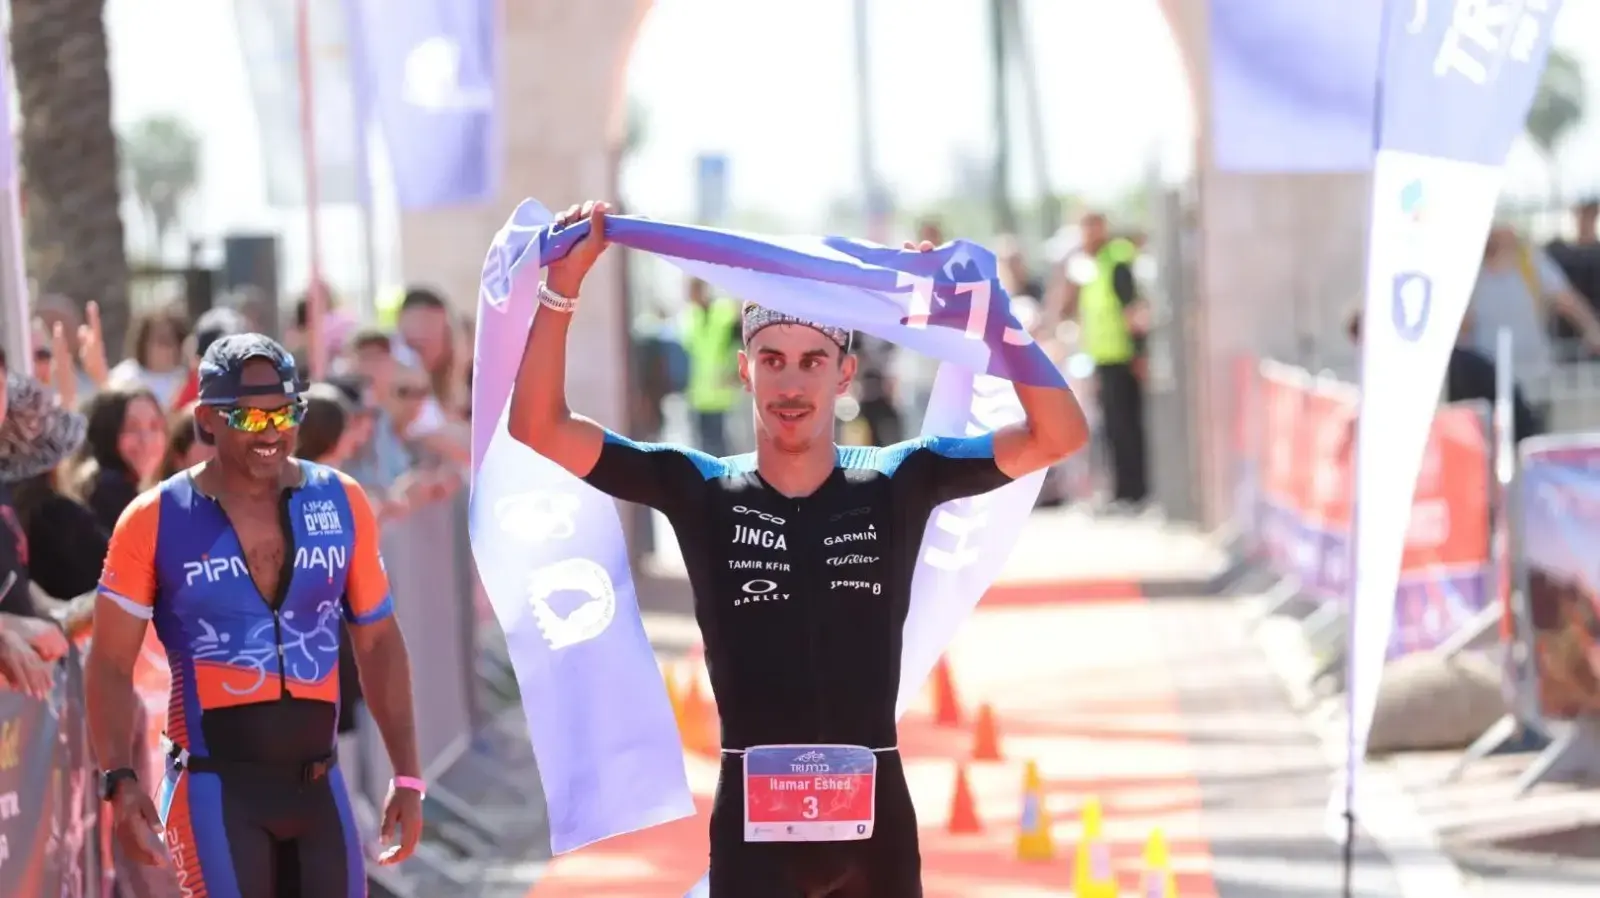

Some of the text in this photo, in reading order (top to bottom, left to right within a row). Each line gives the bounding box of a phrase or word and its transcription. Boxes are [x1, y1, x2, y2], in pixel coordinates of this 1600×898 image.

[732, 525, 788, 551] JINGA
[823, 531, 877, 546] GARMIN
[728, 560, 791, 572] TAMIR KFIR
[826, 554, 880, 566] Wilier
[830, 580, 870, 590] SPONSER
[734, 593, 790, 606] OAKLEY
[769, 777, 852, 790] Itamar Eshed
[802, 795, 819, 819] 3
